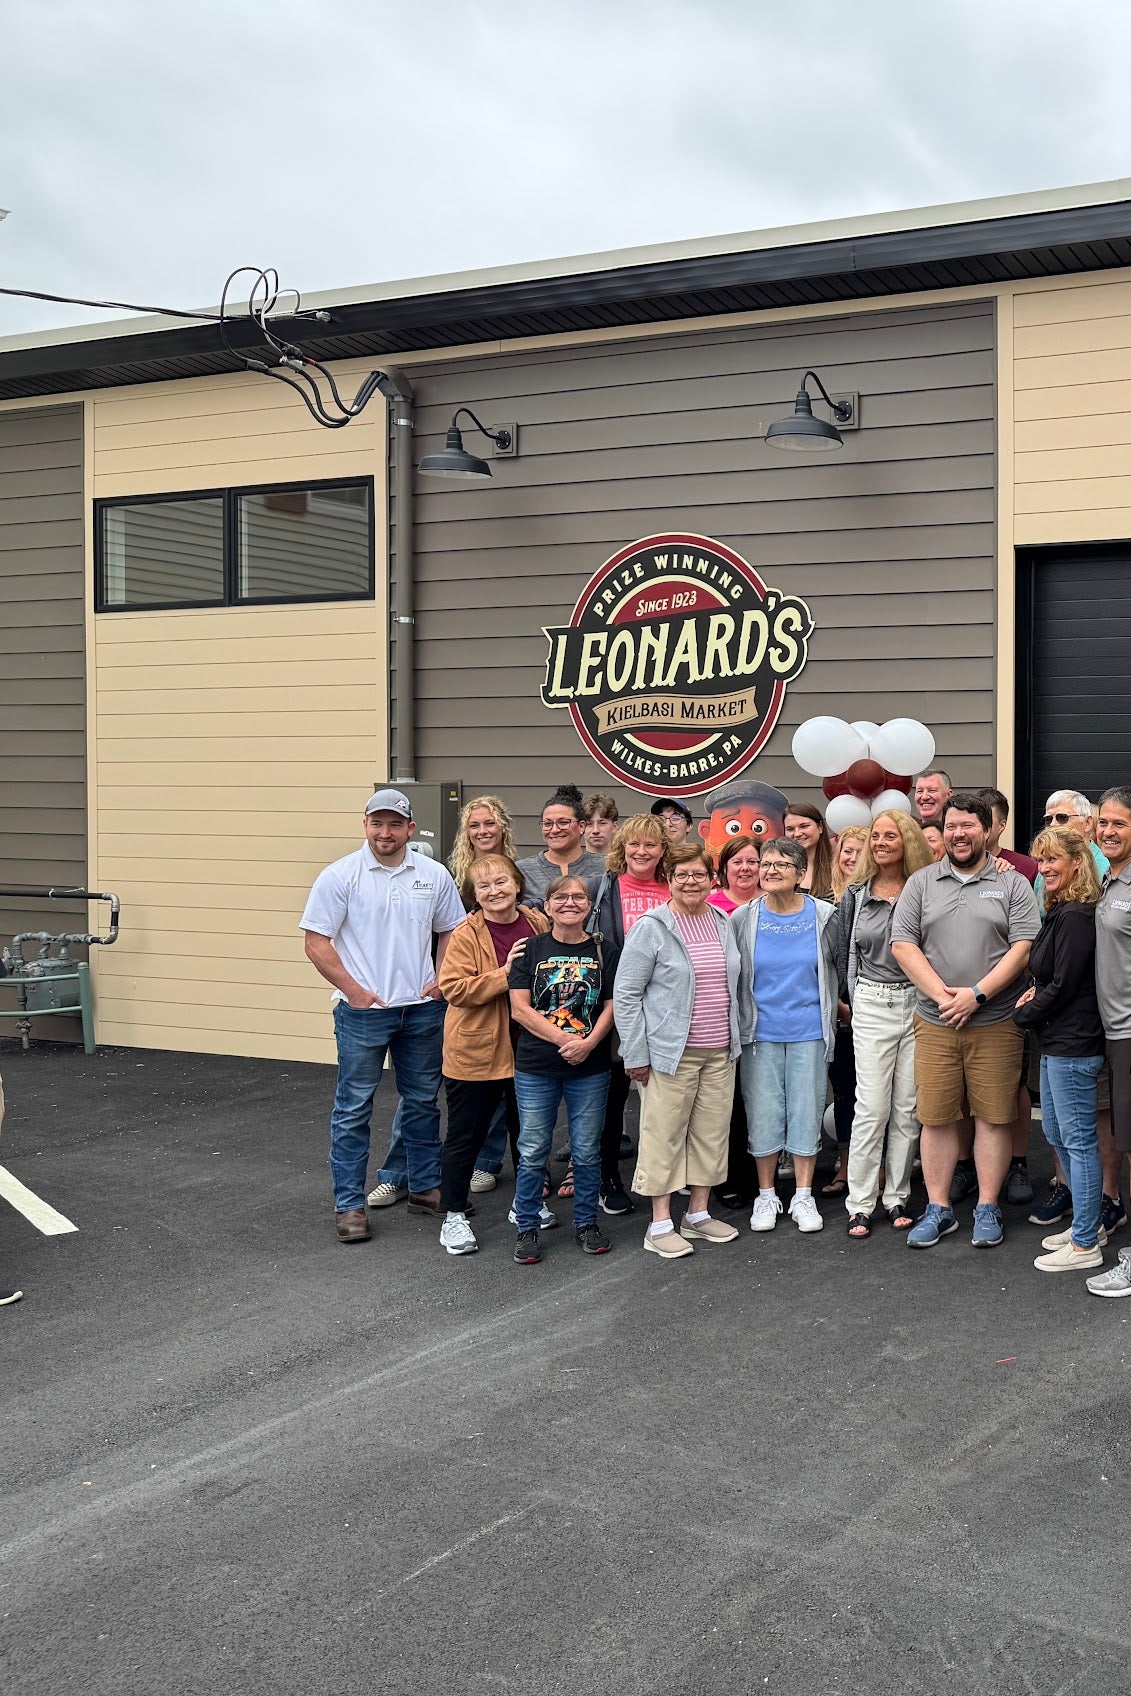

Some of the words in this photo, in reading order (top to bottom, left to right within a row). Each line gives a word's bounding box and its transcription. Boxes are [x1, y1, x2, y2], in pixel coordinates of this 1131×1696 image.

[593, 562, 646, 618] PRIZE
[653, 553, 743, 600] WINNING
[671, 590, 697, 609] 1923
[548, 596, 804, 699] LEONARD'S
[606, 698, 675, 727] KIELBASI
[680, 698, 748, 720] MARKET
[610, 738, 724, 779] WILKES-BARRE,
[722, 733, 743, 758] PA
[622, 898, 645, 912] TER
[539, 956, 599, 969] STAR
